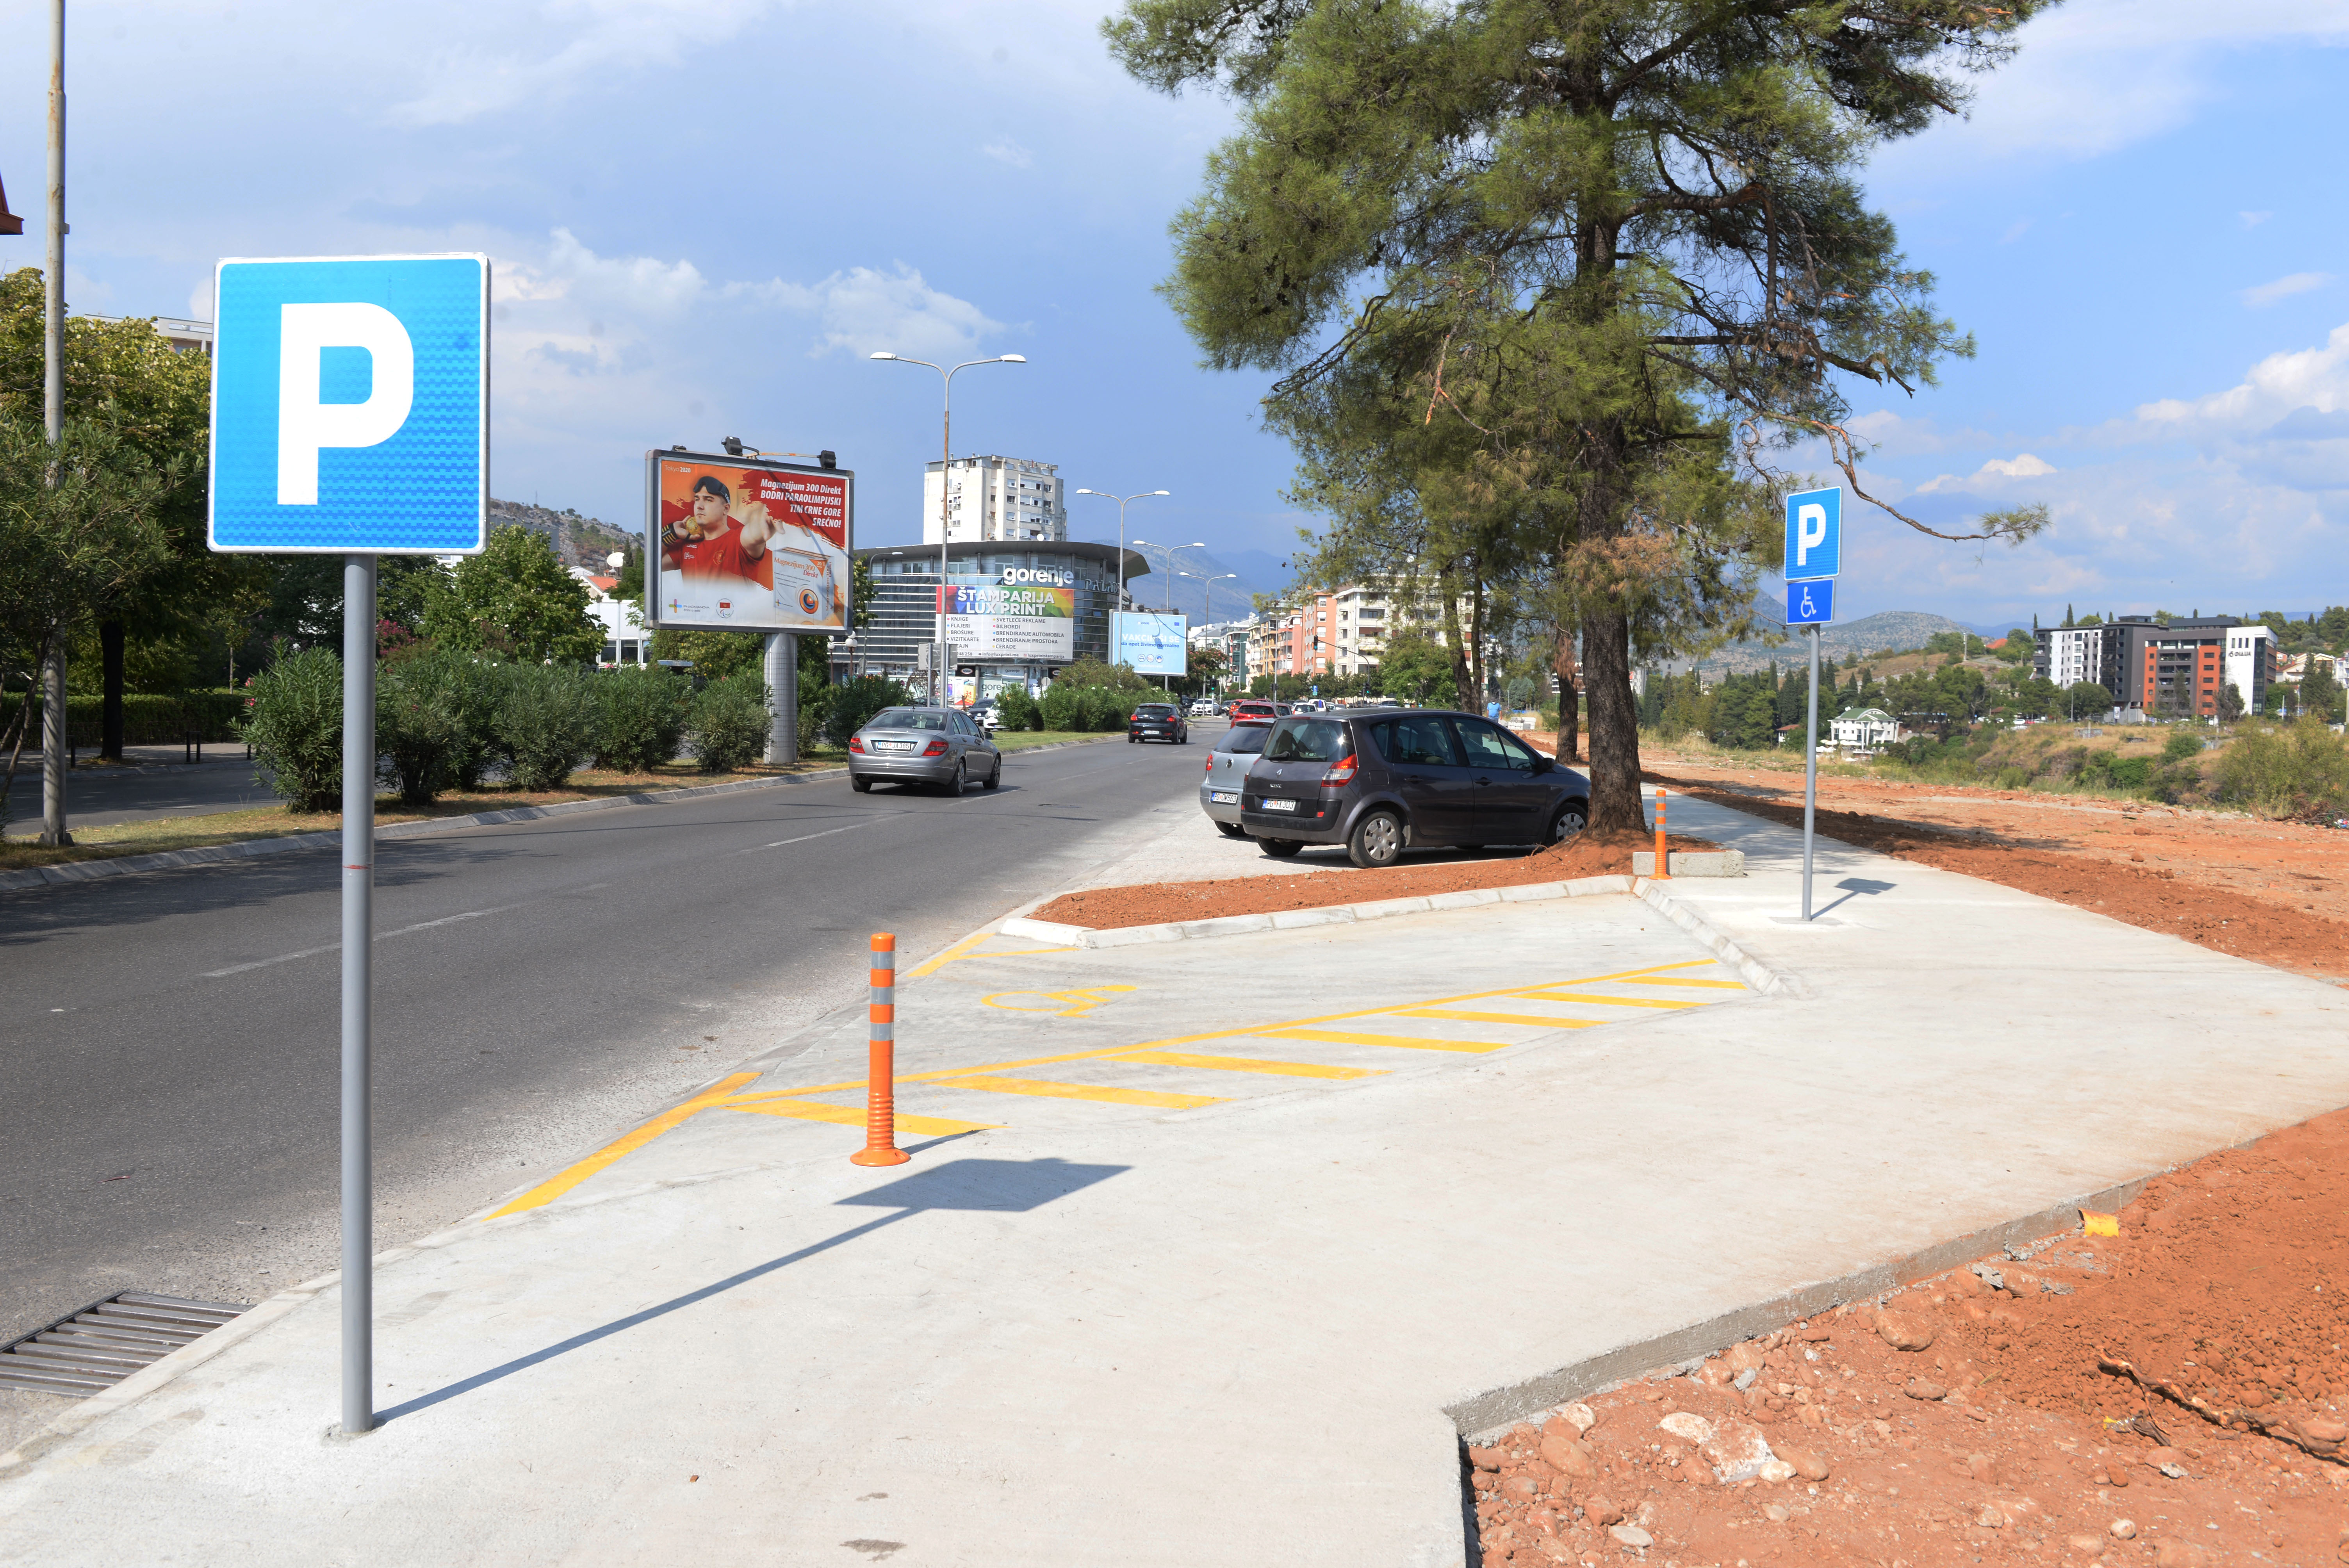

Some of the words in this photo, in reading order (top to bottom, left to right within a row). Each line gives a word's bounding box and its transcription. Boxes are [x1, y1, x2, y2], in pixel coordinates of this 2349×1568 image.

[277, 302, 414, 505] P
[760, 479, 805, 492] Magnezijum
[806, 483, 819, 493] 300
[820, 485, 842, 495] Direkt
[760, 490, 783, 500] BODRI
[785, 492, 841, 506] PARAOLIMPIJSKI
[790, 504, 803, 513] TIM
[804, 505, 822, 515] CRNE
[823, 508, 841, 517] GORE
[812, 517, 842, 528] SREĆNO!
[1797, 503, 1827, 566] P
[773, 557, 805, 569] Magnezijum
[805, 563, 815, 572] 300
[803, 570, 819, 578] Direkt
[1003, 566, 1074, 587] gorenje
[1084, 578, 1120, 593] PALAD
[957, 586, 1055, 604] ŠTAMPARIJA
[966, 602, 997, 614] LUX
[1000, 602, 1045, 615] PRINT
